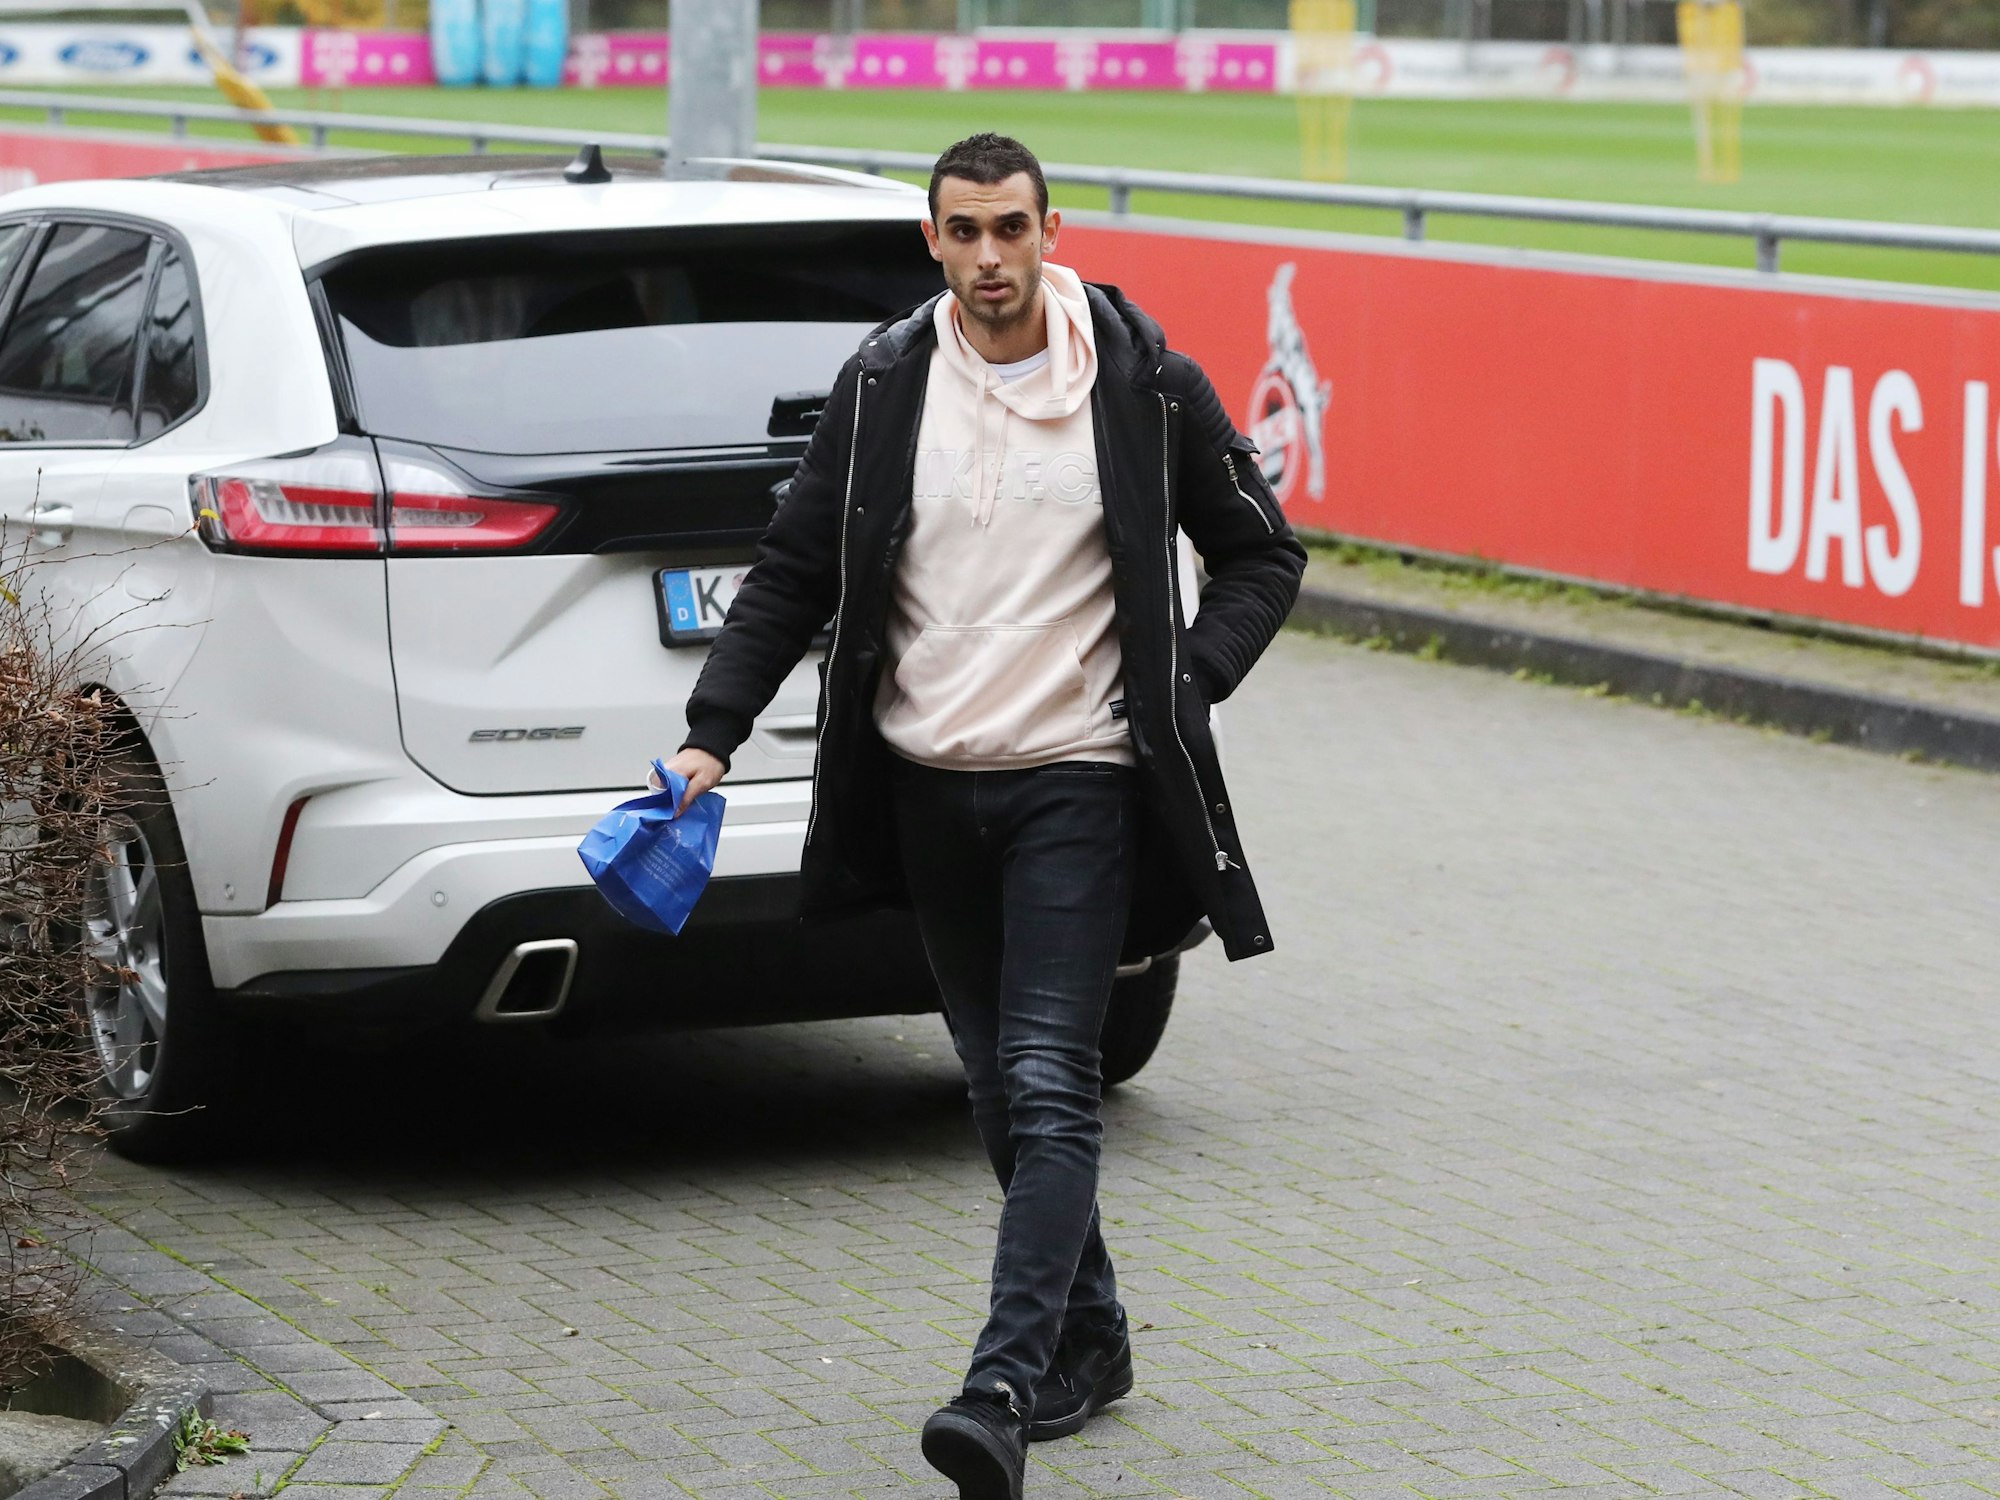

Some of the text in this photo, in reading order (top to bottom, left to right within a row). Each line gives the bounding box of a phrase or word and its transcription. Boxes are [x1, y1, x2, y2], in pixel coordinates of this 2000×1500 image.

[1748, 357, 2000, 608] DAS I
[677, 607, 689, 621] D
[469, 726, 586, 743] EDGE
